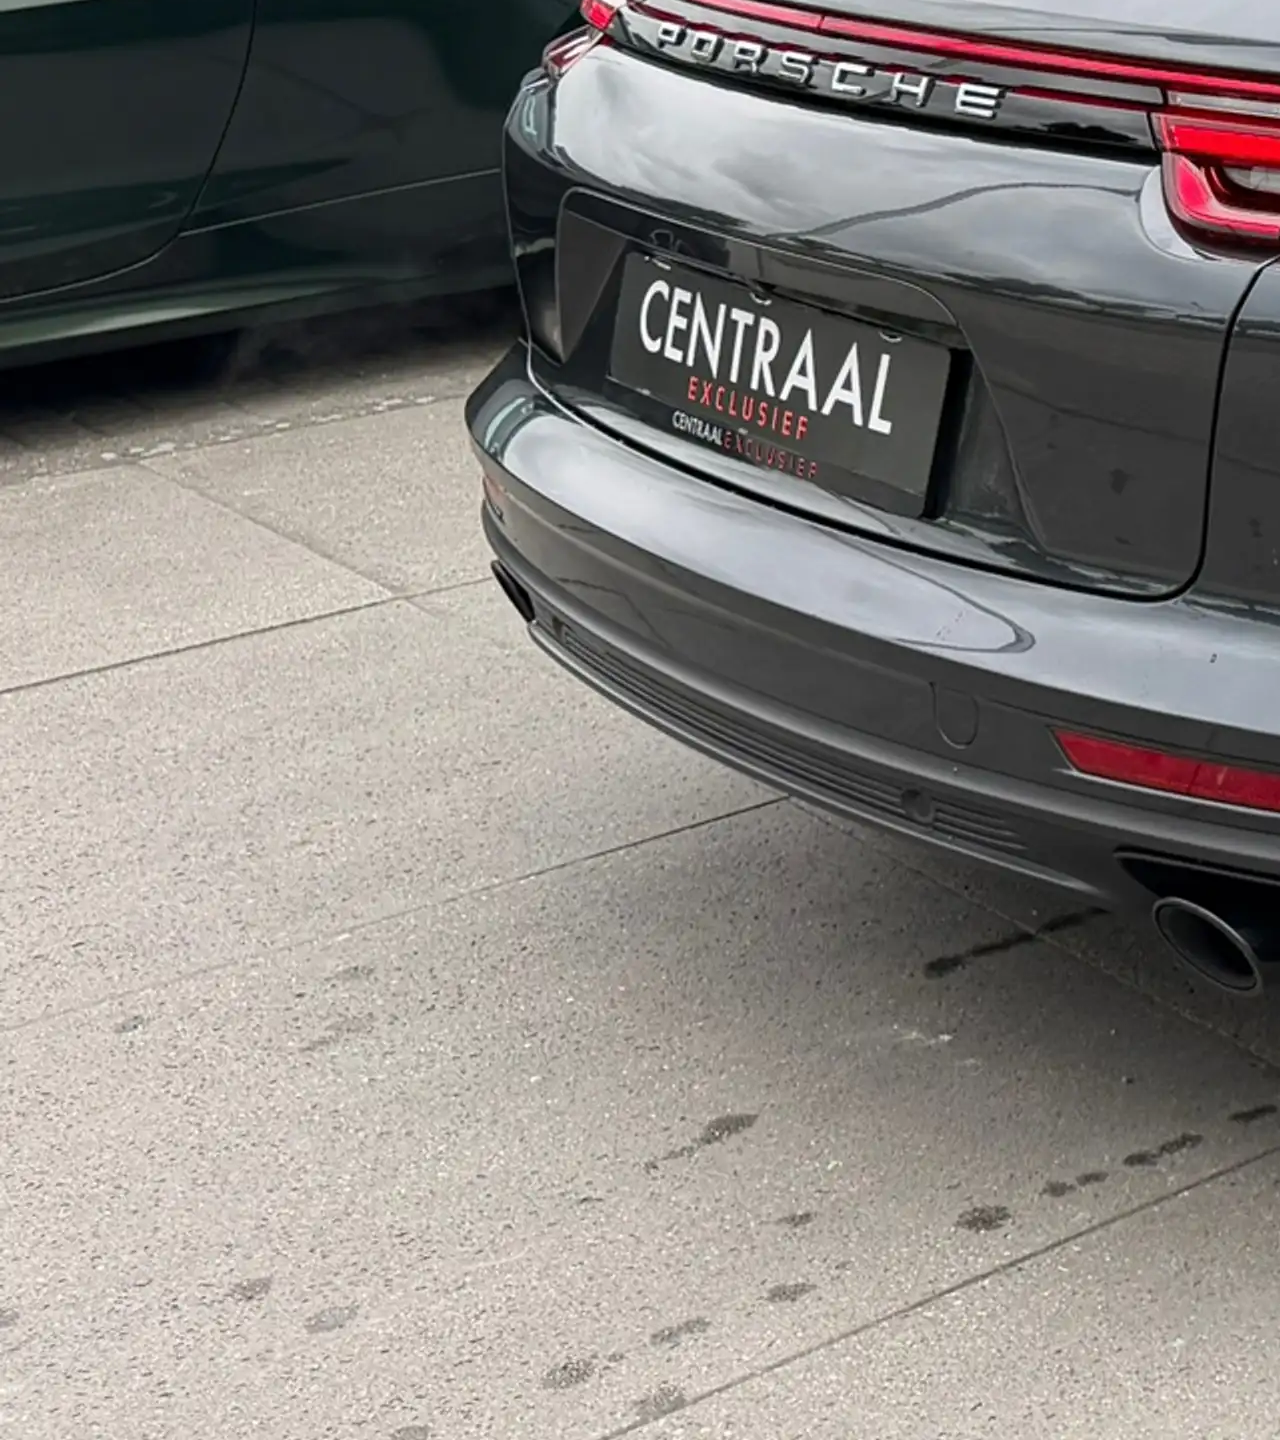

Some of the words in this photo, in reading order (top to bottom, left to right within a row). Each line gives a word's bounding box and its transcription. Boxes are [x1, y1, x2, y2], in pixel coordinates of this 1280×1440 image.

[656, 21, 1004, 120] PORSCHE
[639, 279, 892, 435] CENTRAAL
[687, 375, 809, 441] EXCLUSIEF
[722, 428, 819, 479] EXCLUSIEF
